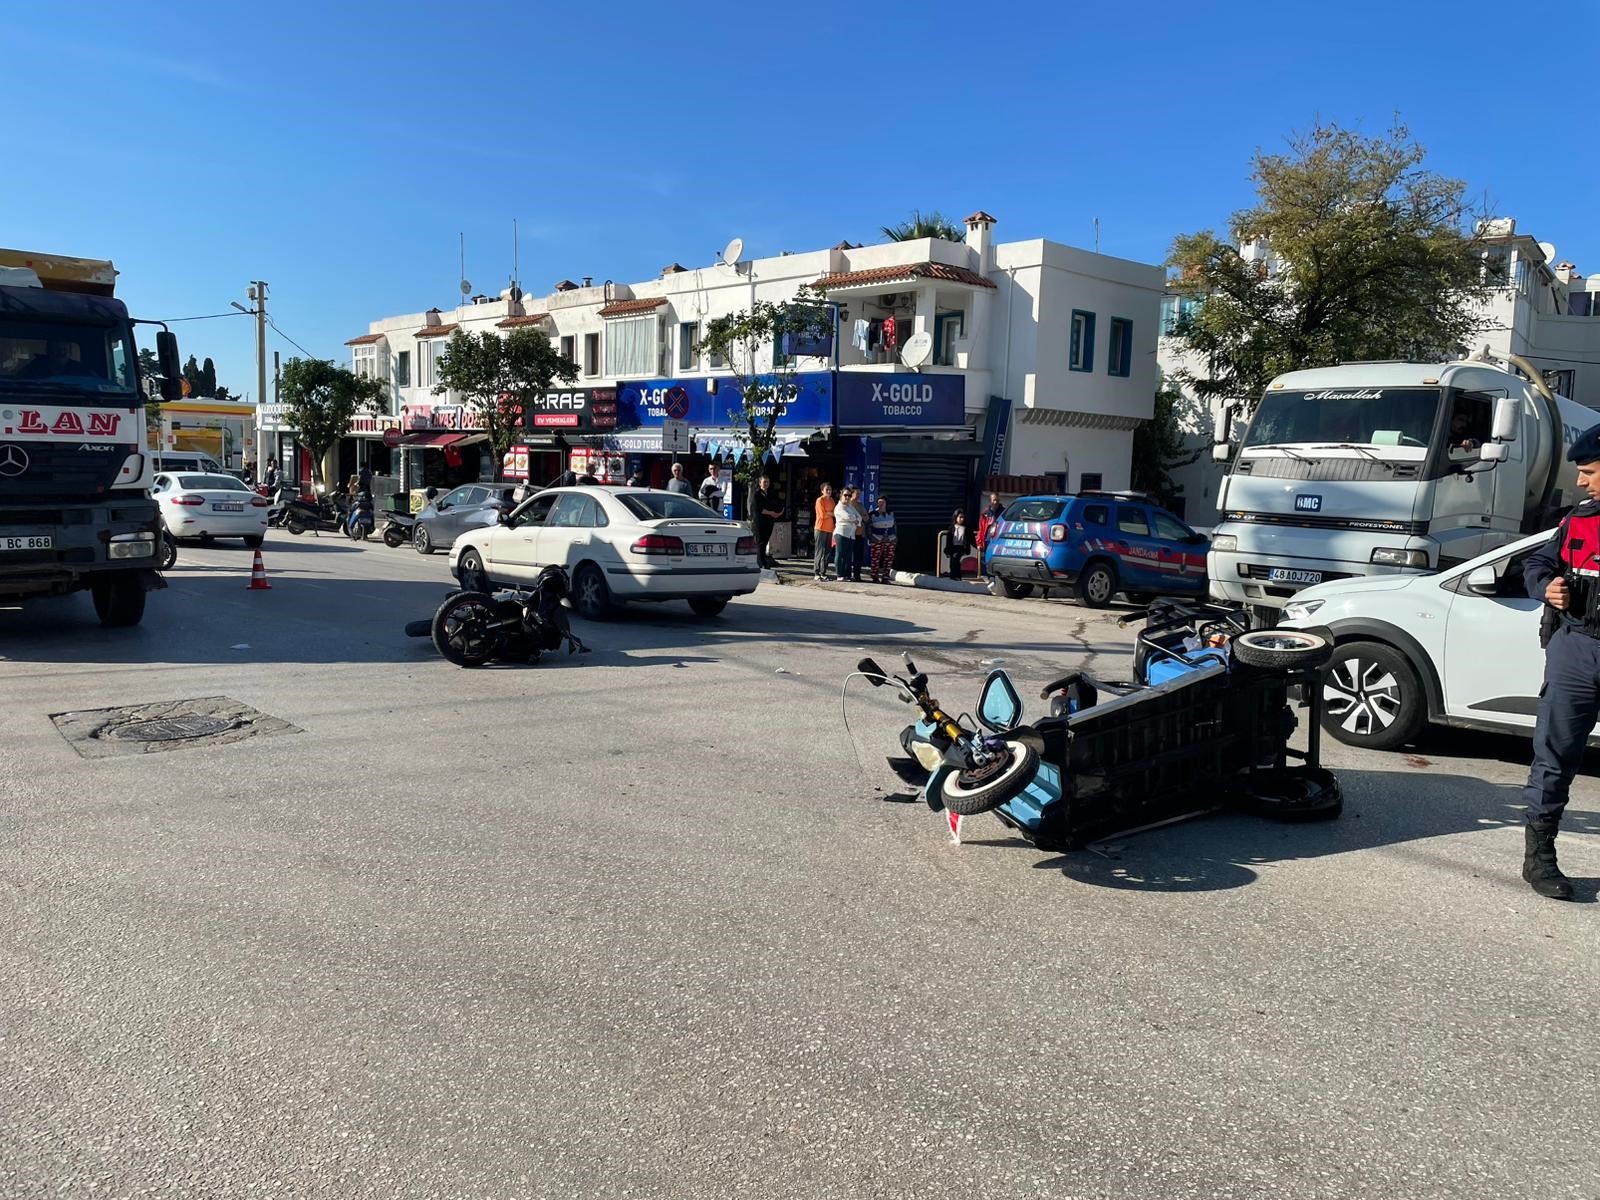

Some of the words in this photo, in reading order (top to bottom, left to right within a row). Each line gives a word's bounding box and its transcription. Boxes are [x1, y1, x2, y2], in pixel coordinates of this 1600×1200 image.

[871, 383, 933, 402] X-GOLD
[883, 405, 922, 415] TOBACCO
[992, 433, 1005, 476] OBACCO
[1296, 496, 1319, 509] BMC
[1349, 521, 1404, 530] PROFESYONEL
[7, 538, 22, 549] BC
[28, 537, 50, 548] 868
